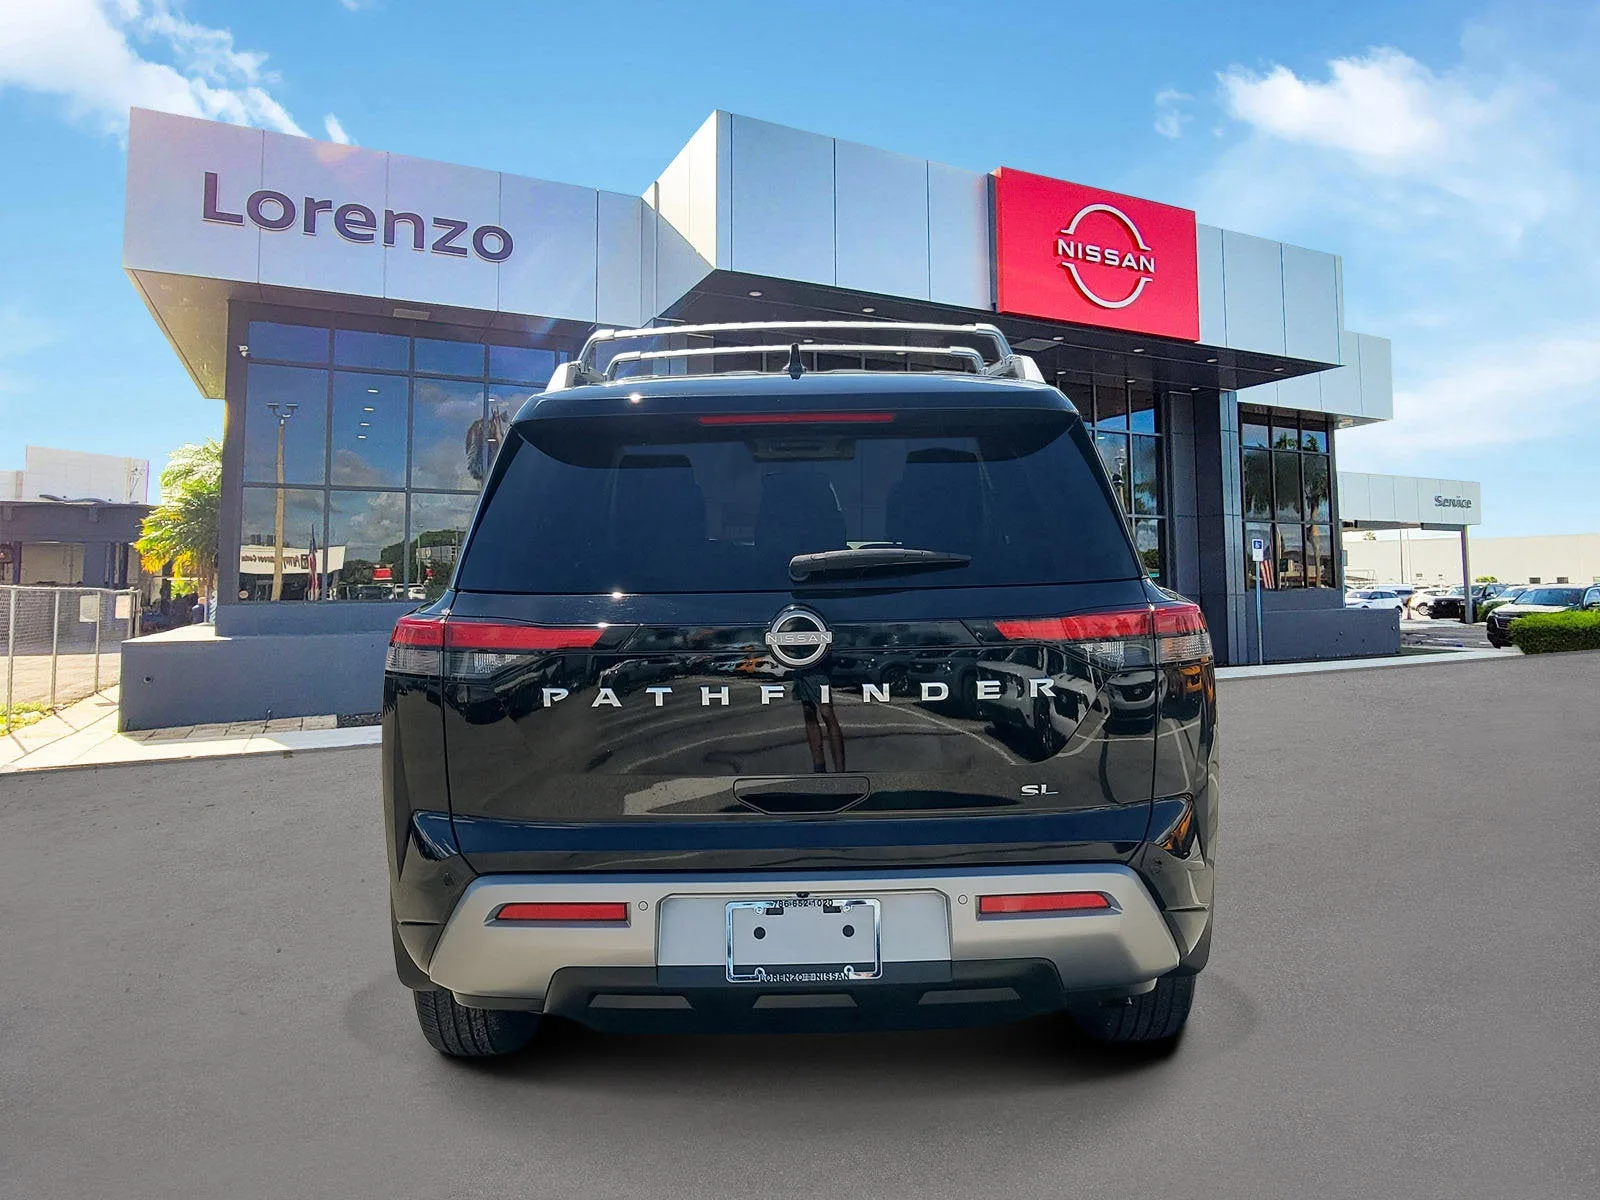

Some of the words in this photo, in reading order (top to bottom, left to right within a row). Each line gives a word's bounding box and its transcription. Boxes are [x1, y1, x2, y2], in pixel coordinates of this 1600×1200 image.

[202, 171, 514, 262] Lorenzo
[1057, 238, 1155, 273] NISSAN
[1434, 495, 1472, 508] Service
[767, 634, 830, 643] NISSAN
[542, 678, 1056, 708] PATHFINDER
[1021, 784, 1059, 796] SL
